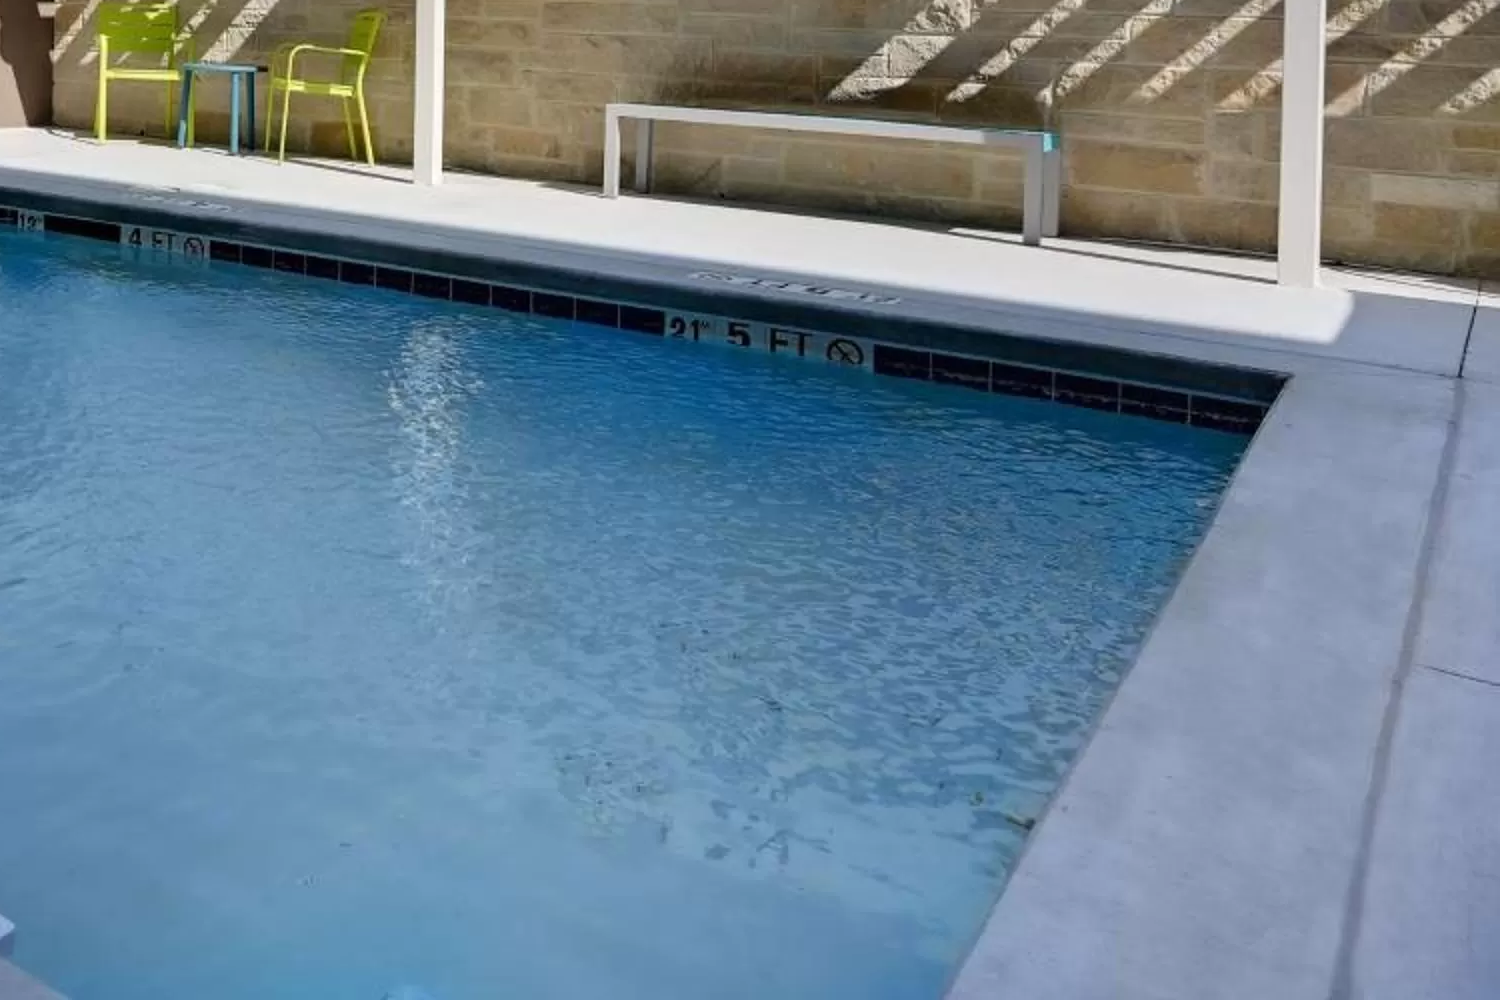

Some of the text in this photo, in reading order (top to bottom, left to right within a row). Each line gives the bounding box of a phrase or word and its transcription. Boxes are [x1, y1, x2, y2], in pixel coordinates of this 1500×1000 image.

[128, 227, 177, 250] 4 FT
[727, 321, 751, 347] 5
[769, 327, 813, 356] FT
